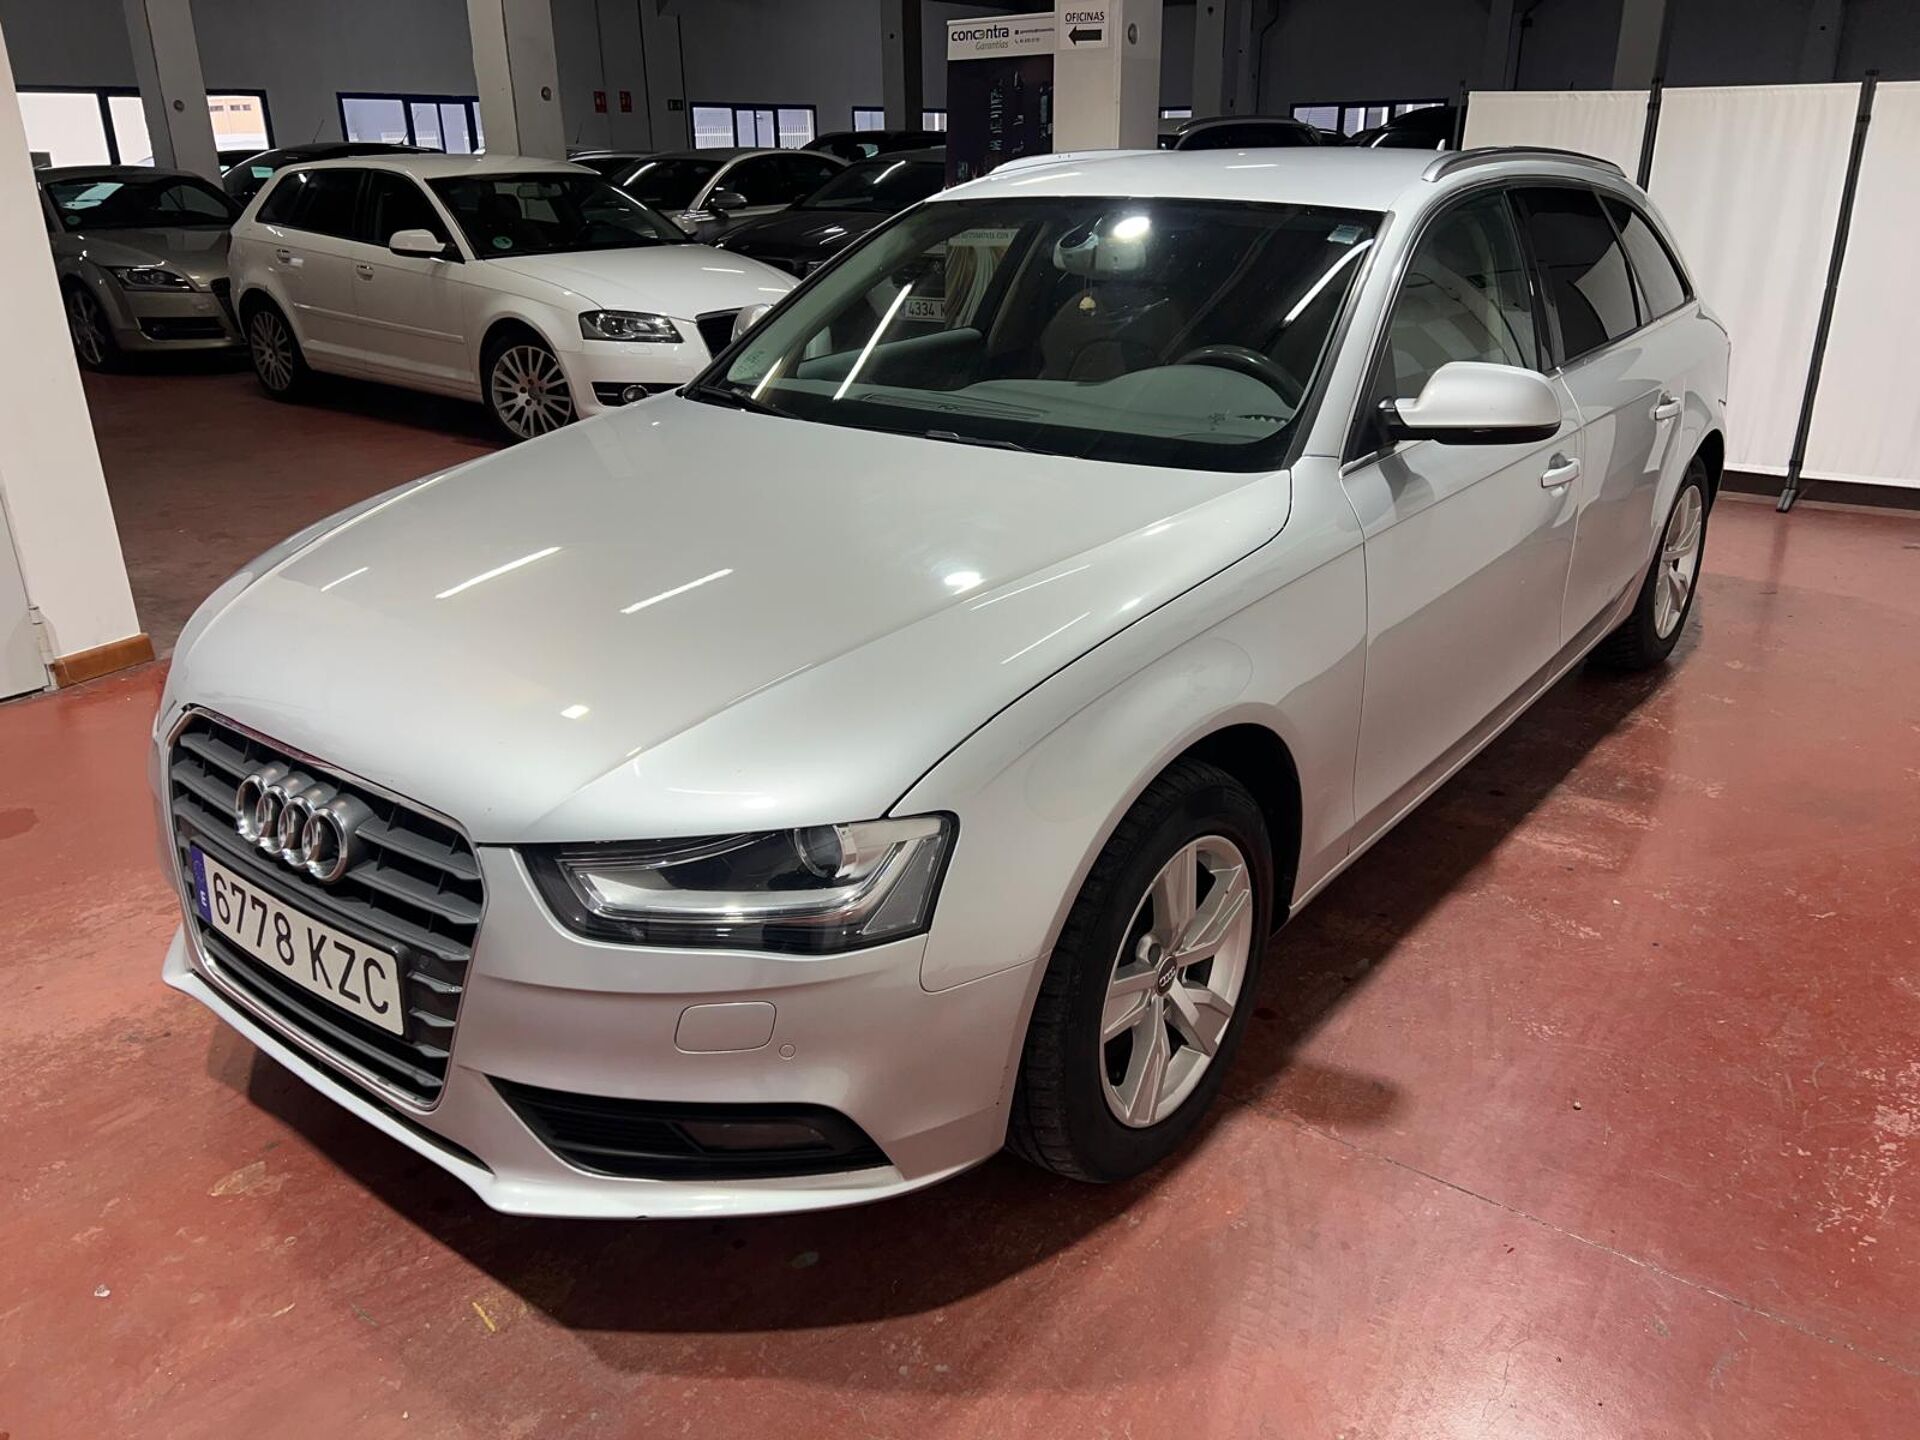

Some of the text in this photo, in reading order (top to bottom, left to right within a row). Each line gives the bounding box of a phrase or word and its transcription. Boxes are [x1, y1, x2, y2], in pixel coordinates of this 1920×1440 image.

[1065, 11, 1105, 22] OFICINAS
[951, 24, 1009, 41] concentra
[909, 302, 935, 316] 4334
[213, 871, 295, 967] 6778
[306, 926, 389, 1015] KZC
